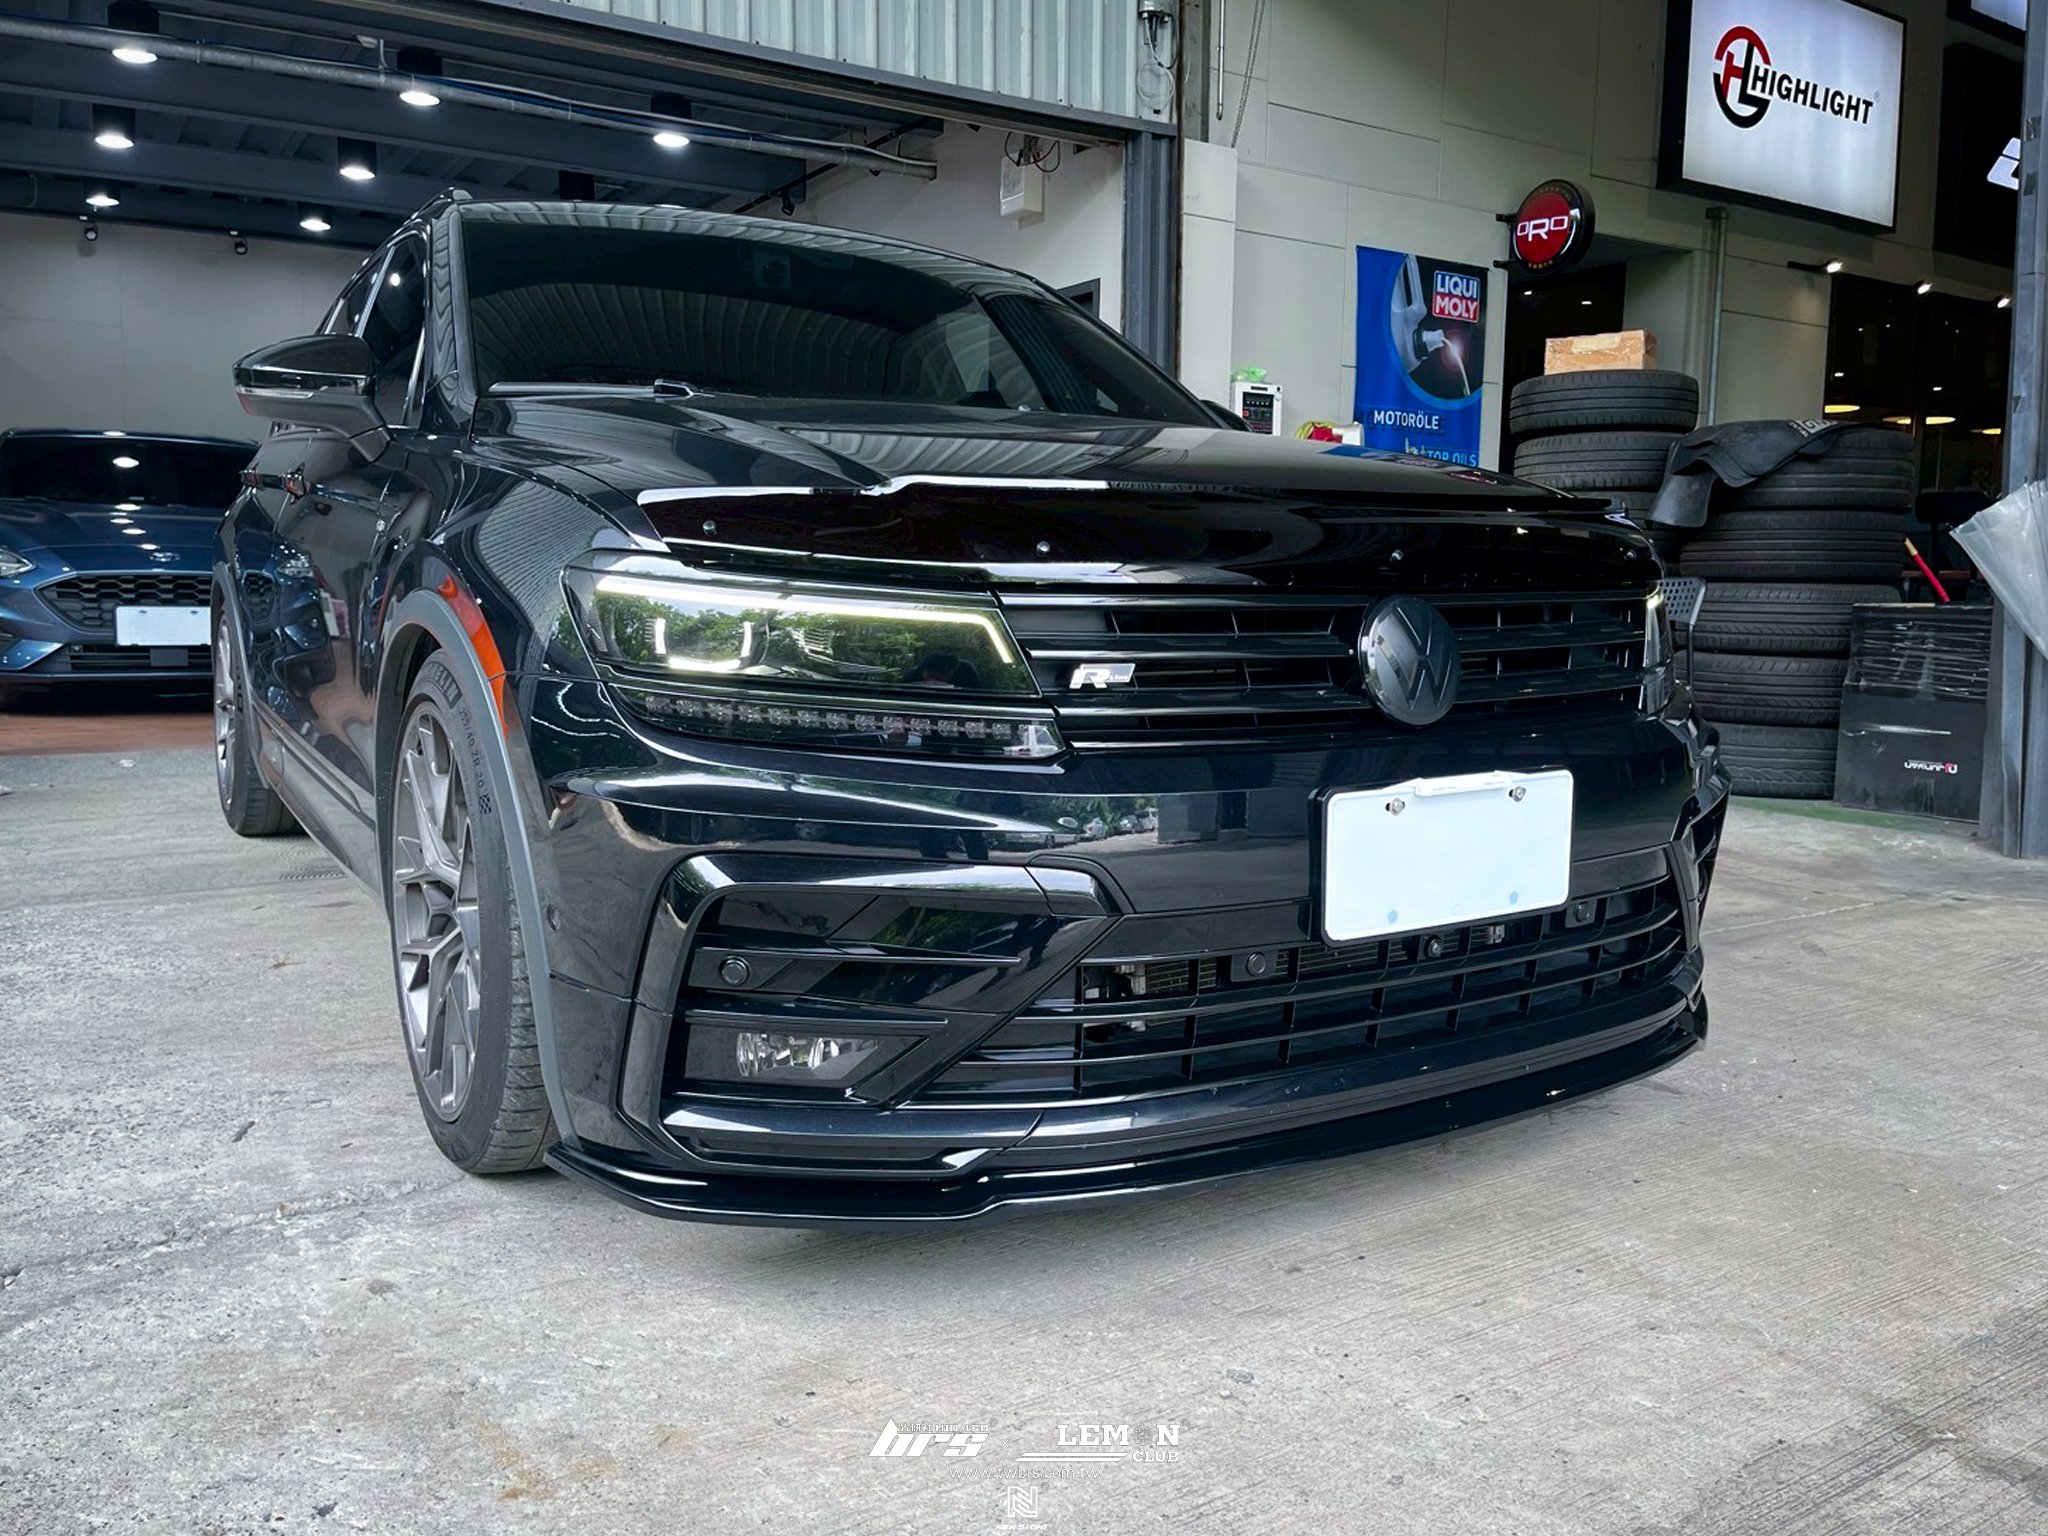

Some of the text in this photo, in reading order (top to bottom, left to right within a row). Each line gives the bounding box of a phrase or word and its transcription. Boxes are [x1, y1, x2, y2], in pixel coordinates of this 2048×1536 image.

[1751, 65, 1874, 124] HIGHLIGHT
[1517, 216, 1569, 242] ORO
[1436, 274, 1478, 299] LIQUI
[1434, 296, 1479, 320] MOLY
[1373, 409, 1440, 430] MOTORÖLE
